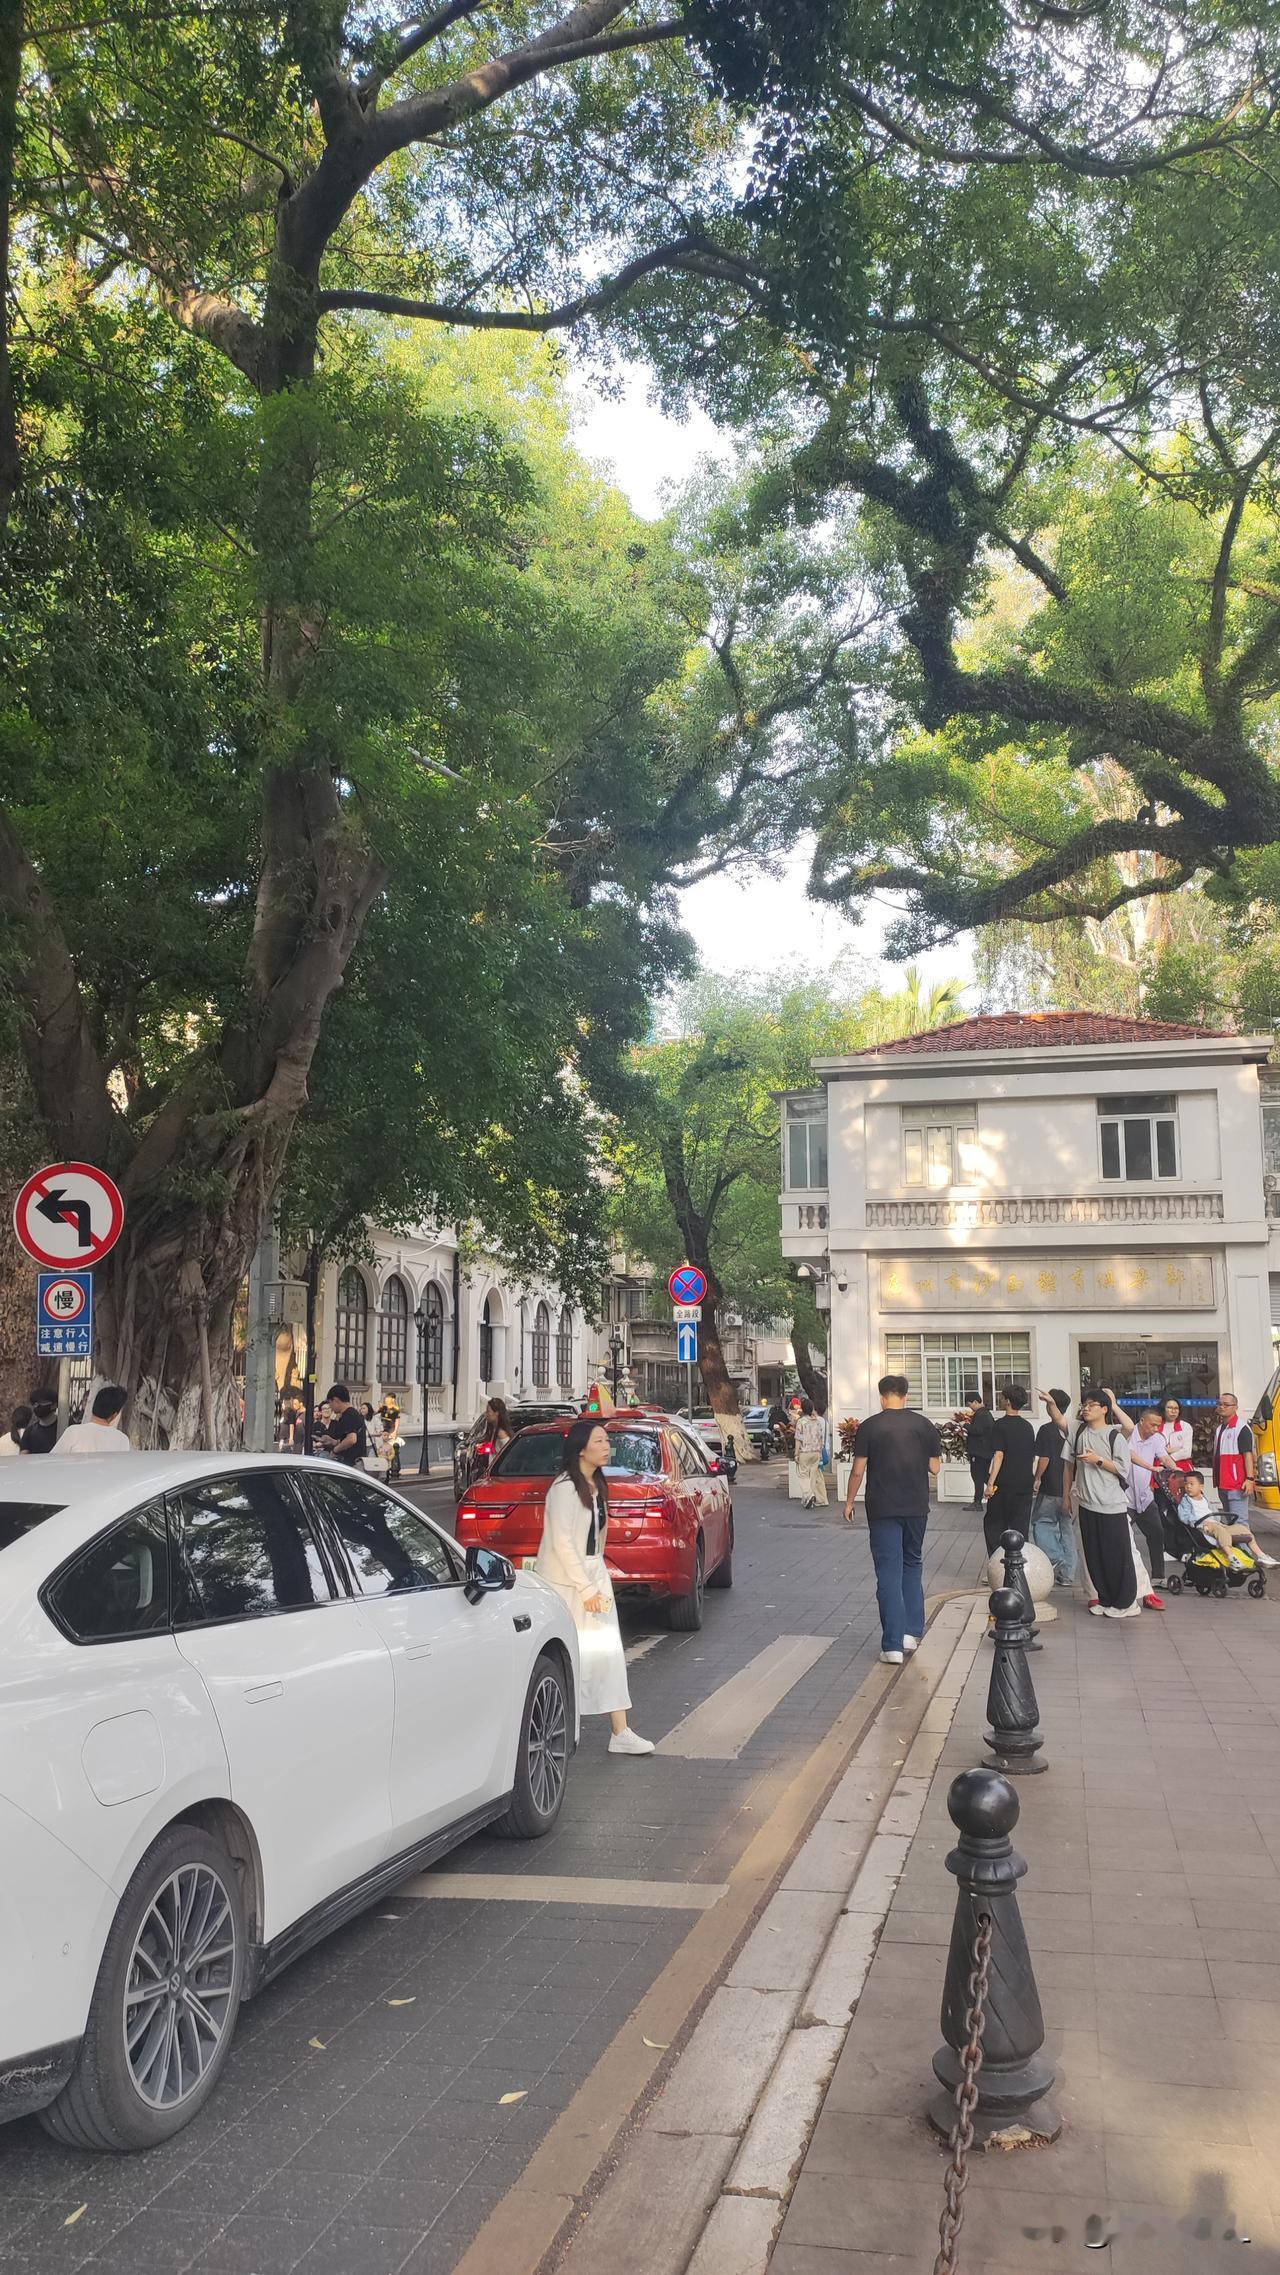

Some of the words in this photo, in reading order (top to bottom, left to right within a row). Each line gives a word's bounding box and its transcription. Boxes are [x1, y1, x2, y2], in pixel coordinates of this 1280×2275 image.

[54, 1290, 74, 1310] 慢
[676, 1309, 700, 1319] 全路段
[41, 1328, 88, 1339] 注意行人
